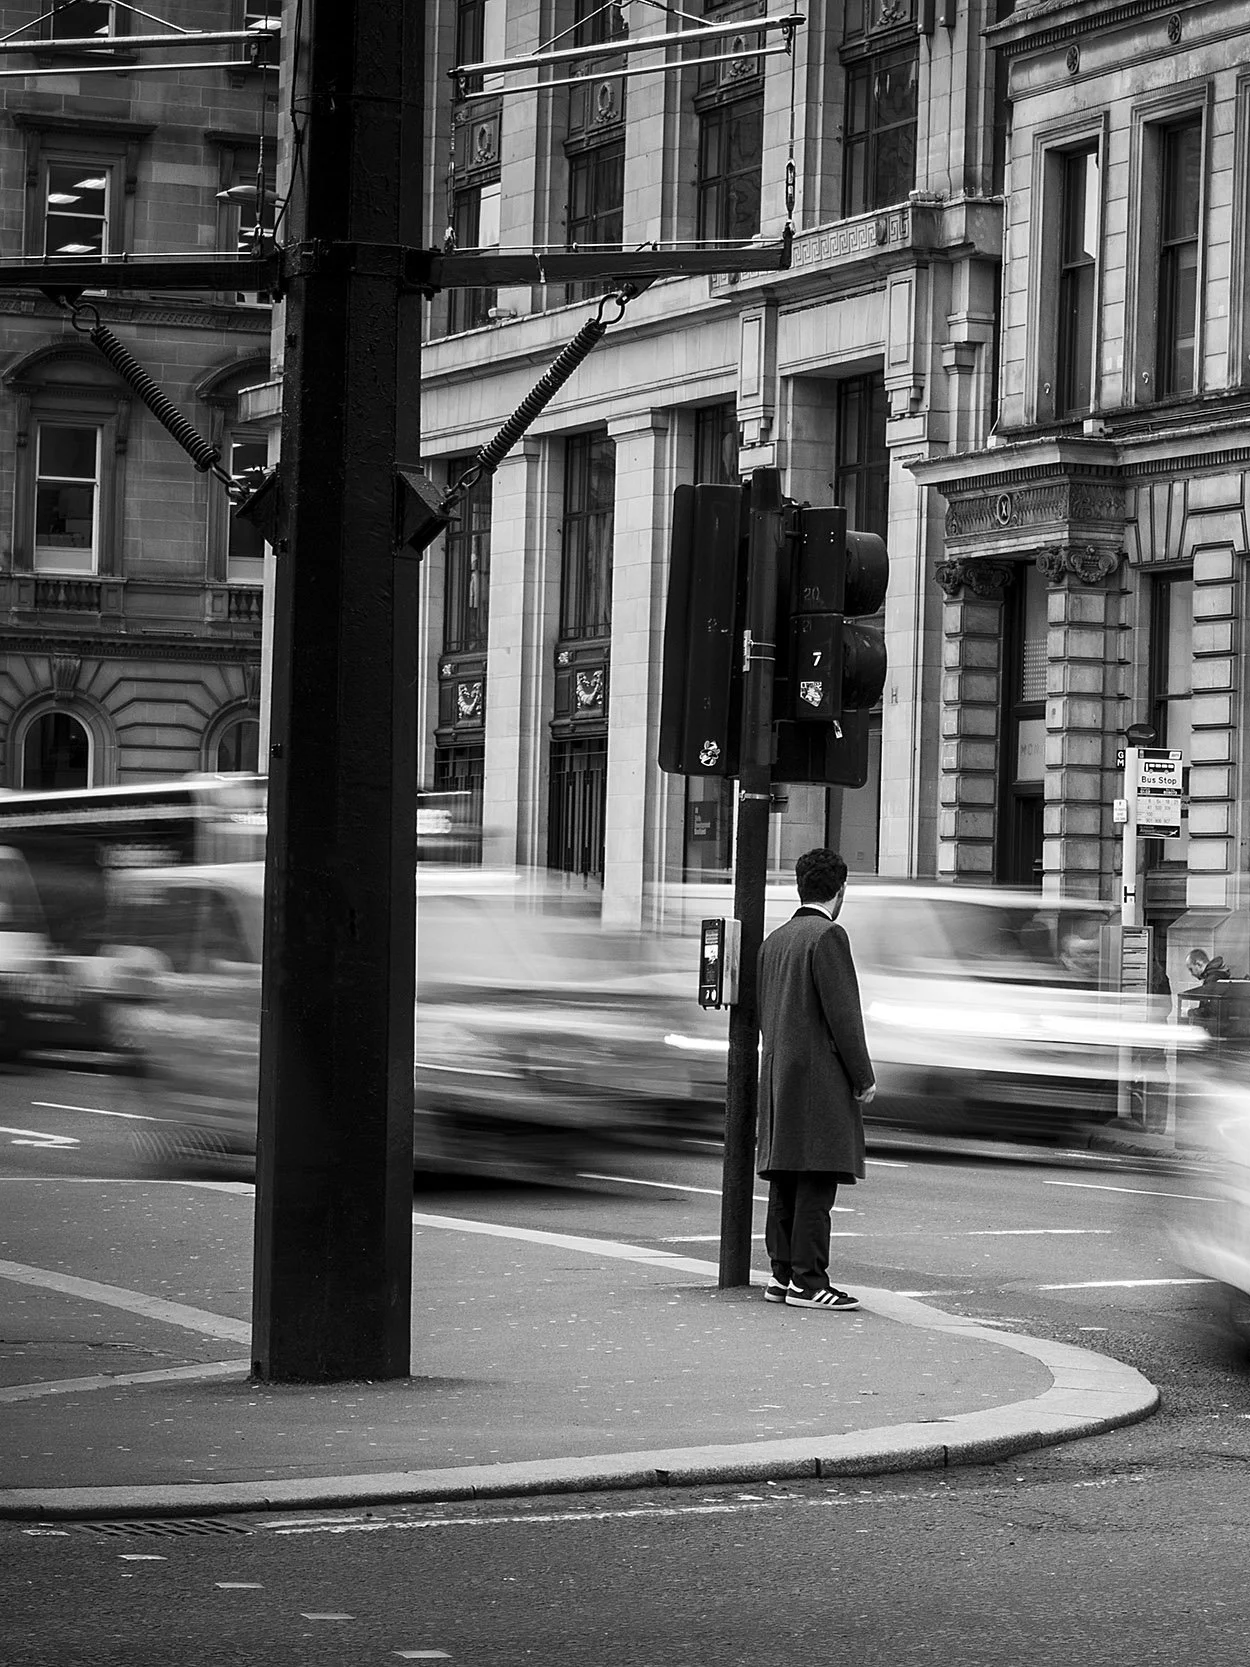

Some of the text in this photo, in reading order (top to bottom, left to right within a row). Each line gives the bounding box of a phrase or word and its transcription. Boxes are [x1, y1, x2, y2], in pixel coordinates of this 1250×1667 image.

[812, 651, 823, 667] 7
[1141, 775, 1177, 785] Bus Stop
